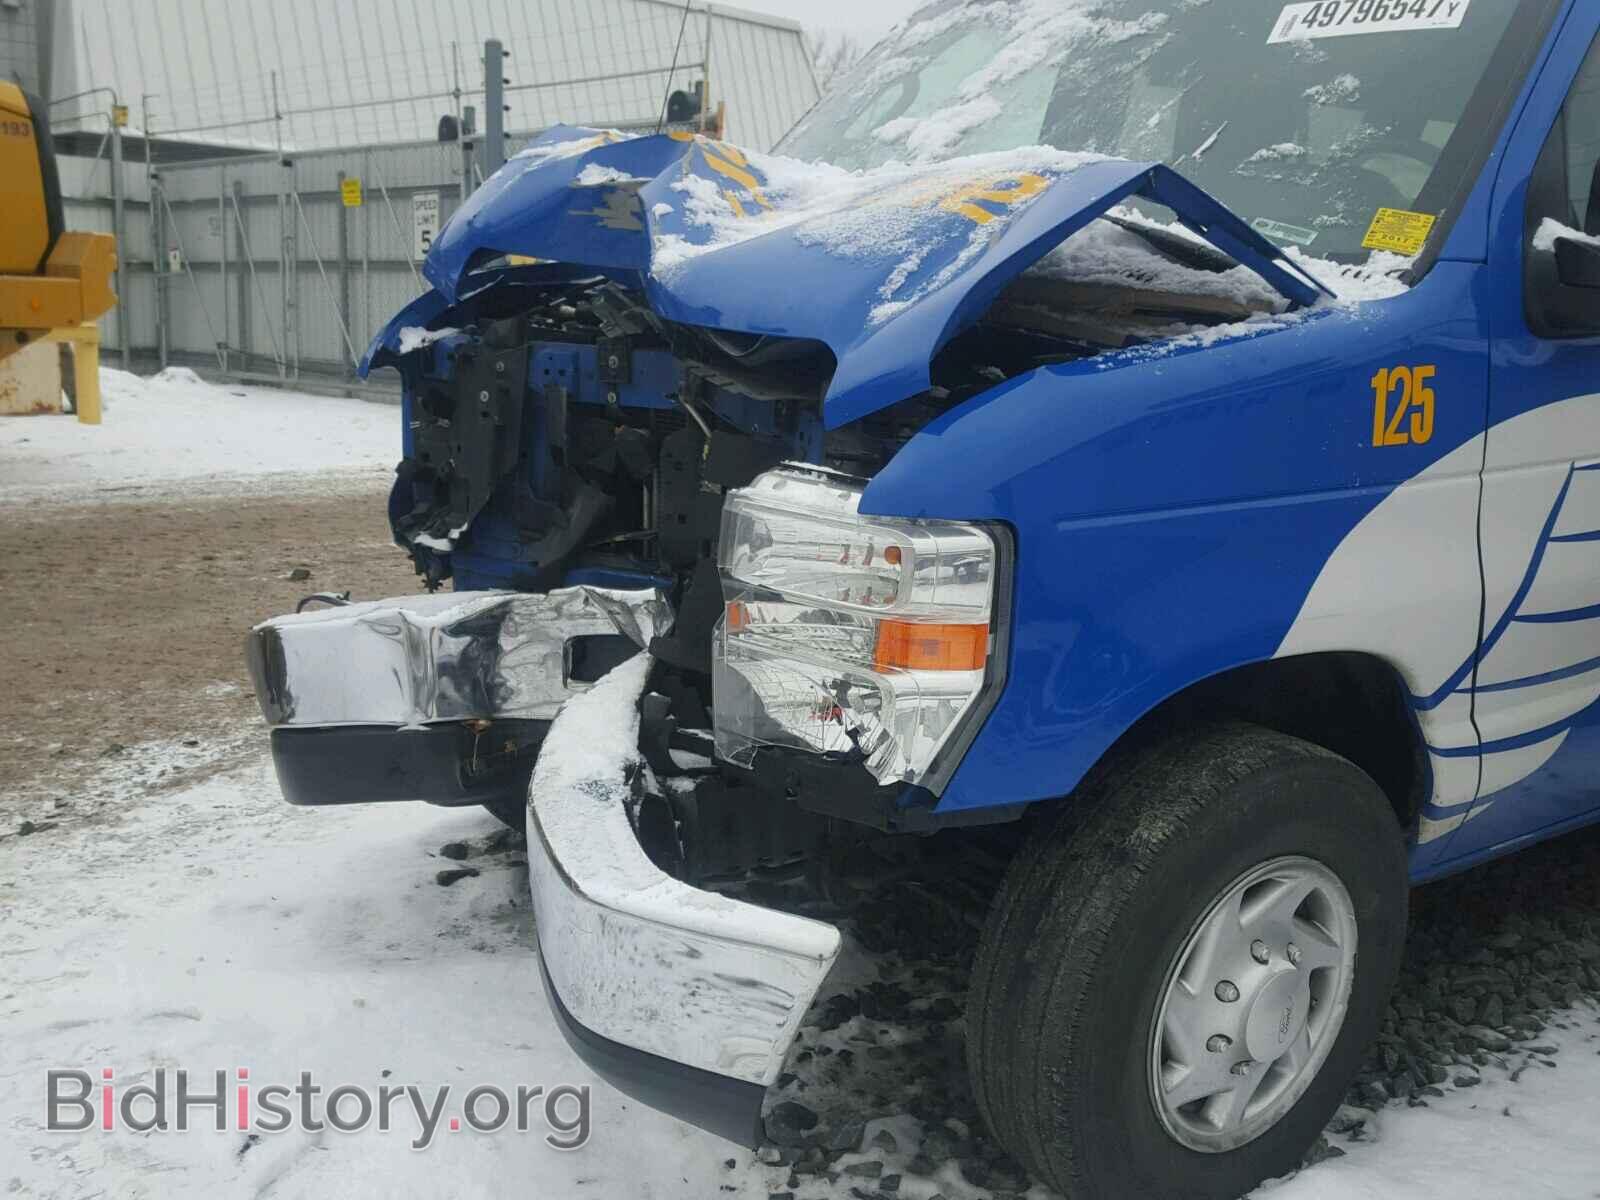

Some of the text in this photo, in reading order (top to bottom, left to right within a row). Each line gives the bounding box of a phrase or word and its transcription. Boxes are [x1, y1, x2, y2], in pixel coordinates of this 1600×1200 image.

[1447, 2, 1460, 17] Y
[415, 200, 437, 210] SPEED
[416, 214, 437, 226] LIMIT
[421, 230, 432, 254] 5
[1371, 365, 1436, 447] 125
